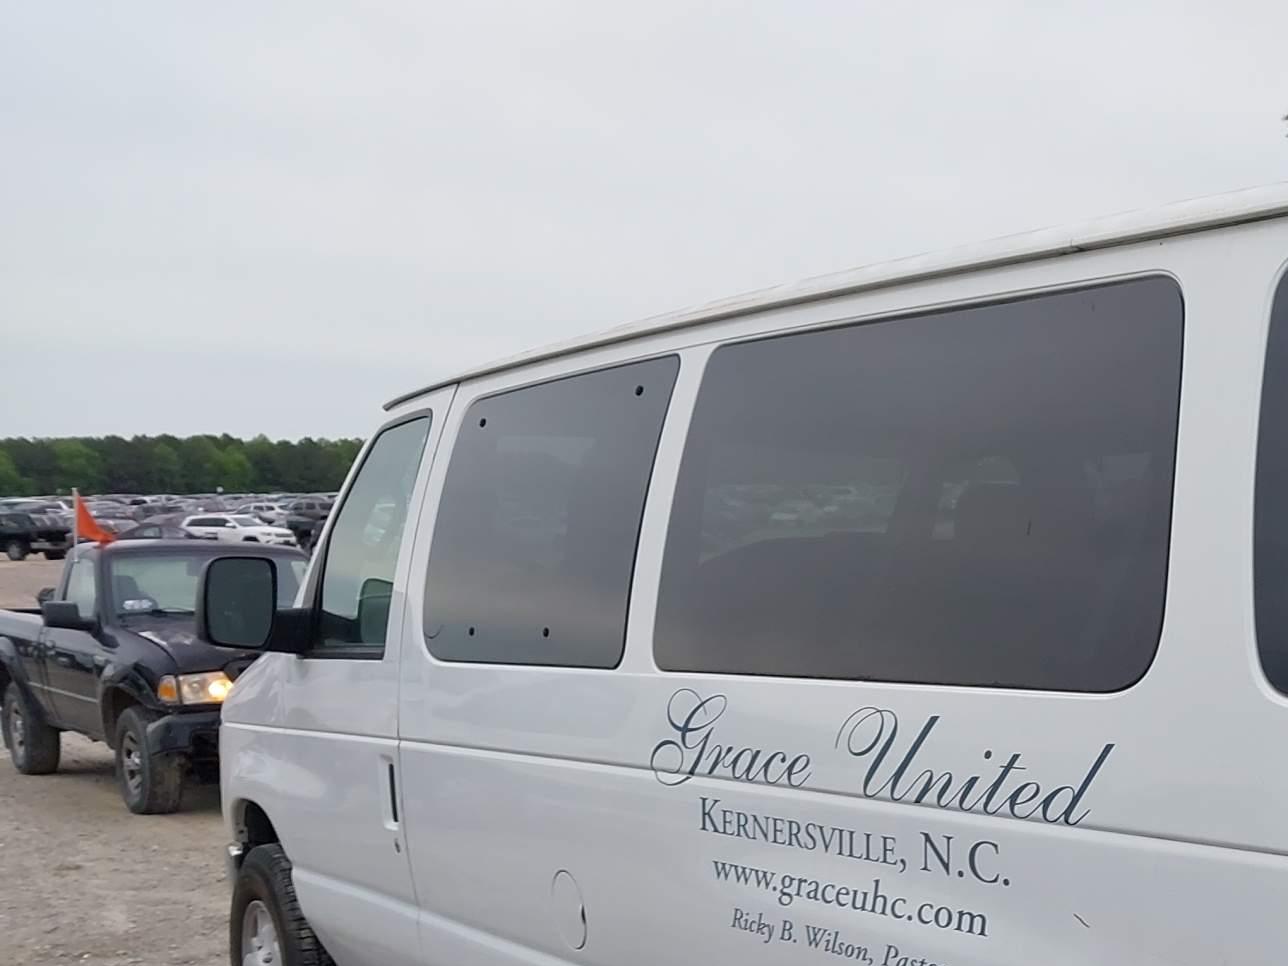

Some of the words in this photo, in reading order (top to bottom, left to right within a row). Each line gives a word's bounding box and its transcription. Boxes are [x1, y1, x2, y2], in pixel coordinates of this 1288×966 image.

[650, 687, 813, 786] Grace
[834, 706, 1116, 826] United
[919, 831, 1011, 887] N.C.
[712, 858, 989, 938] www.graceuhc.com
[730, 907, 776, 944] Ricky
[779, 920, 798, 944] B.
[804, 924, 875, 966] Wilson,
